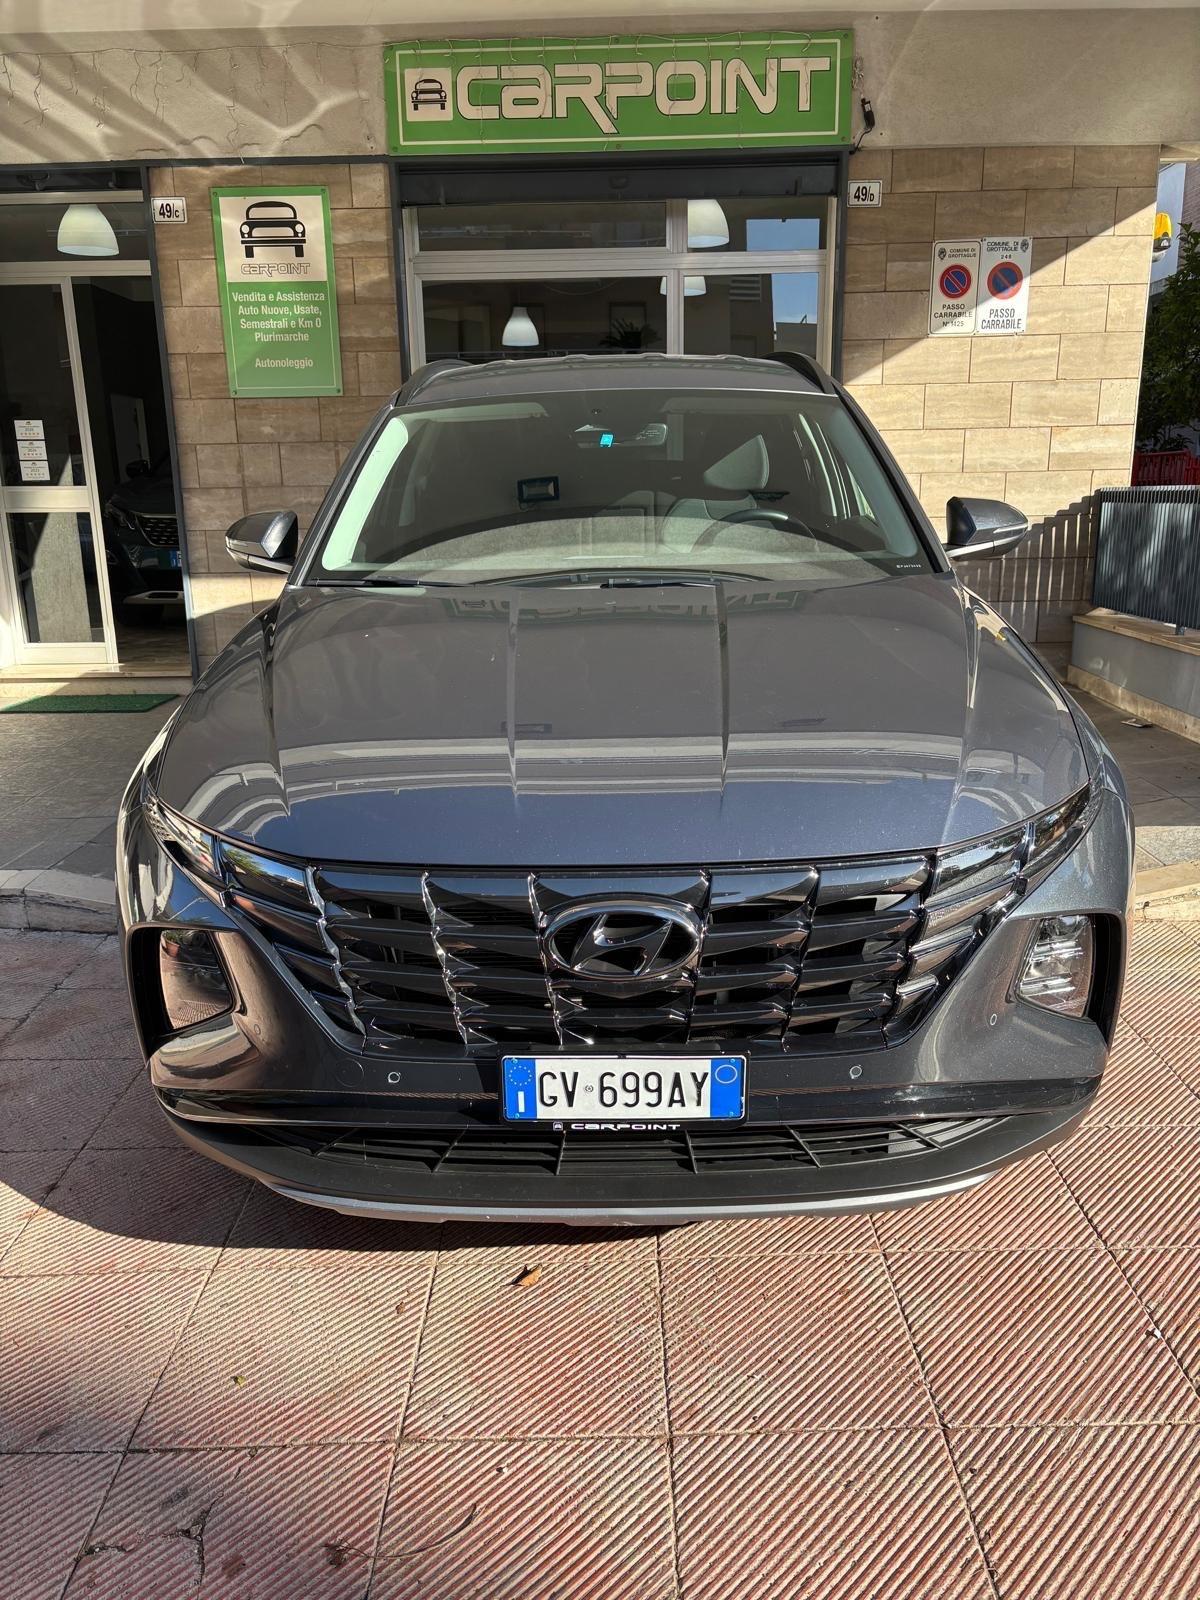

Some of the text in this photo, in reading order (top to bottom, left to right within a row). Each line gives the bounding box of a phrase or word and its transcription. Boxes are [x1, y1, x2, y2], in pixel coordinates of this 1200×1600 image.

[232, 292, 266, 302] Vendita
[276, 291, 325, 302] Assistenza
[238, 304, 322, 317] Auto Nuove, Usate,
[933, 311, 973, 319] CARRABILE
[989, 308, 1015, 318] PASSO
[240, 318, 288, 329] Semestrali
[298, 318, 314, 328] Km
[315, 318, 321, 328] 0
[981, 319, 1022, 330] CARRABILE
[255, 332, 309, 342] Plurimarche
[255, 357, 314, 369] Autonoleggio
[539, 1071, 579, 1108] GV
[598, 1071, 709, 1108] 699AY
